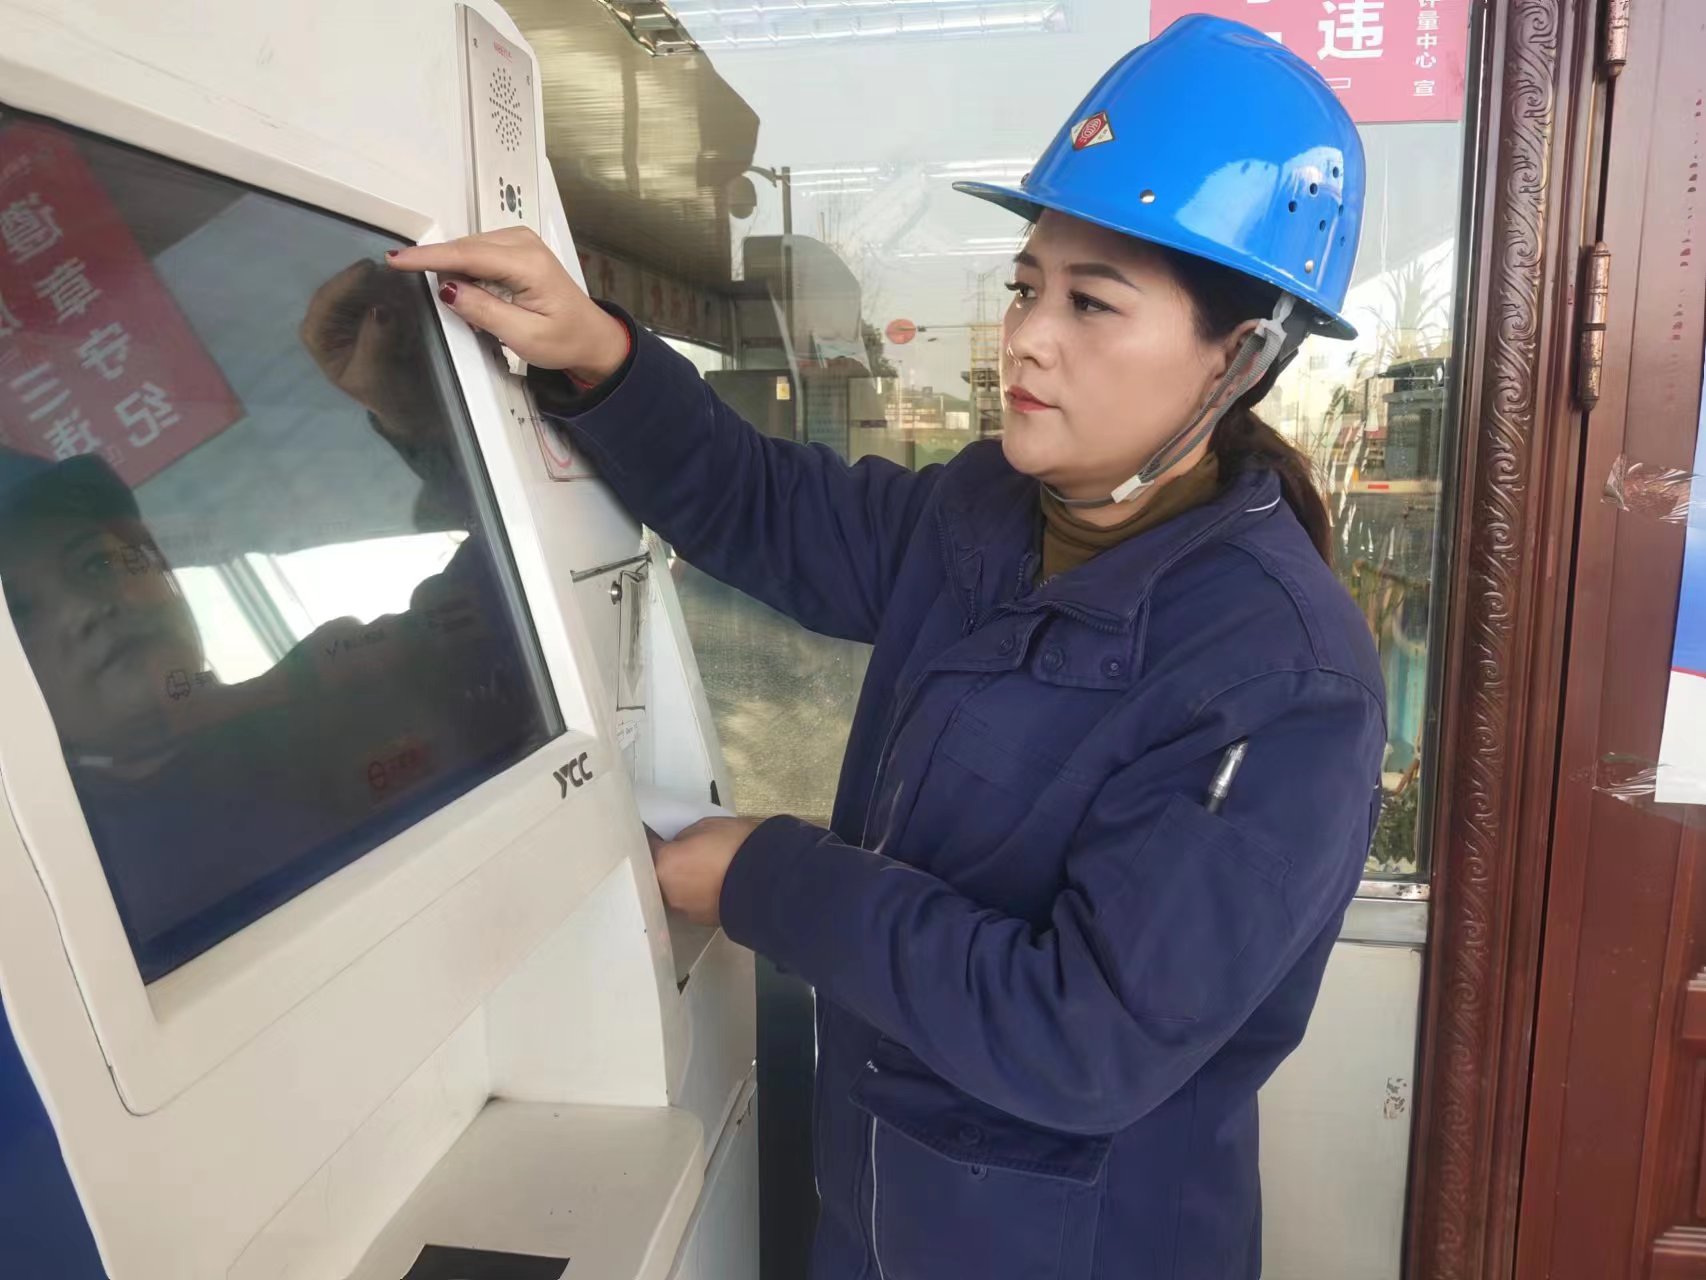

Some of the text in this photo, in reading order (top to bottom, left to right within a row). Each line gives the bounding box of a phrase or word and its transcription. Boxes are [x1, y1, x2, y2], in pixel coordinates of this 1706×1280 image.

[1317, 0, 1385, 61] 违
[1413, 79, 1435, 97] 宣
[553, 751, 593, 800] YCC
